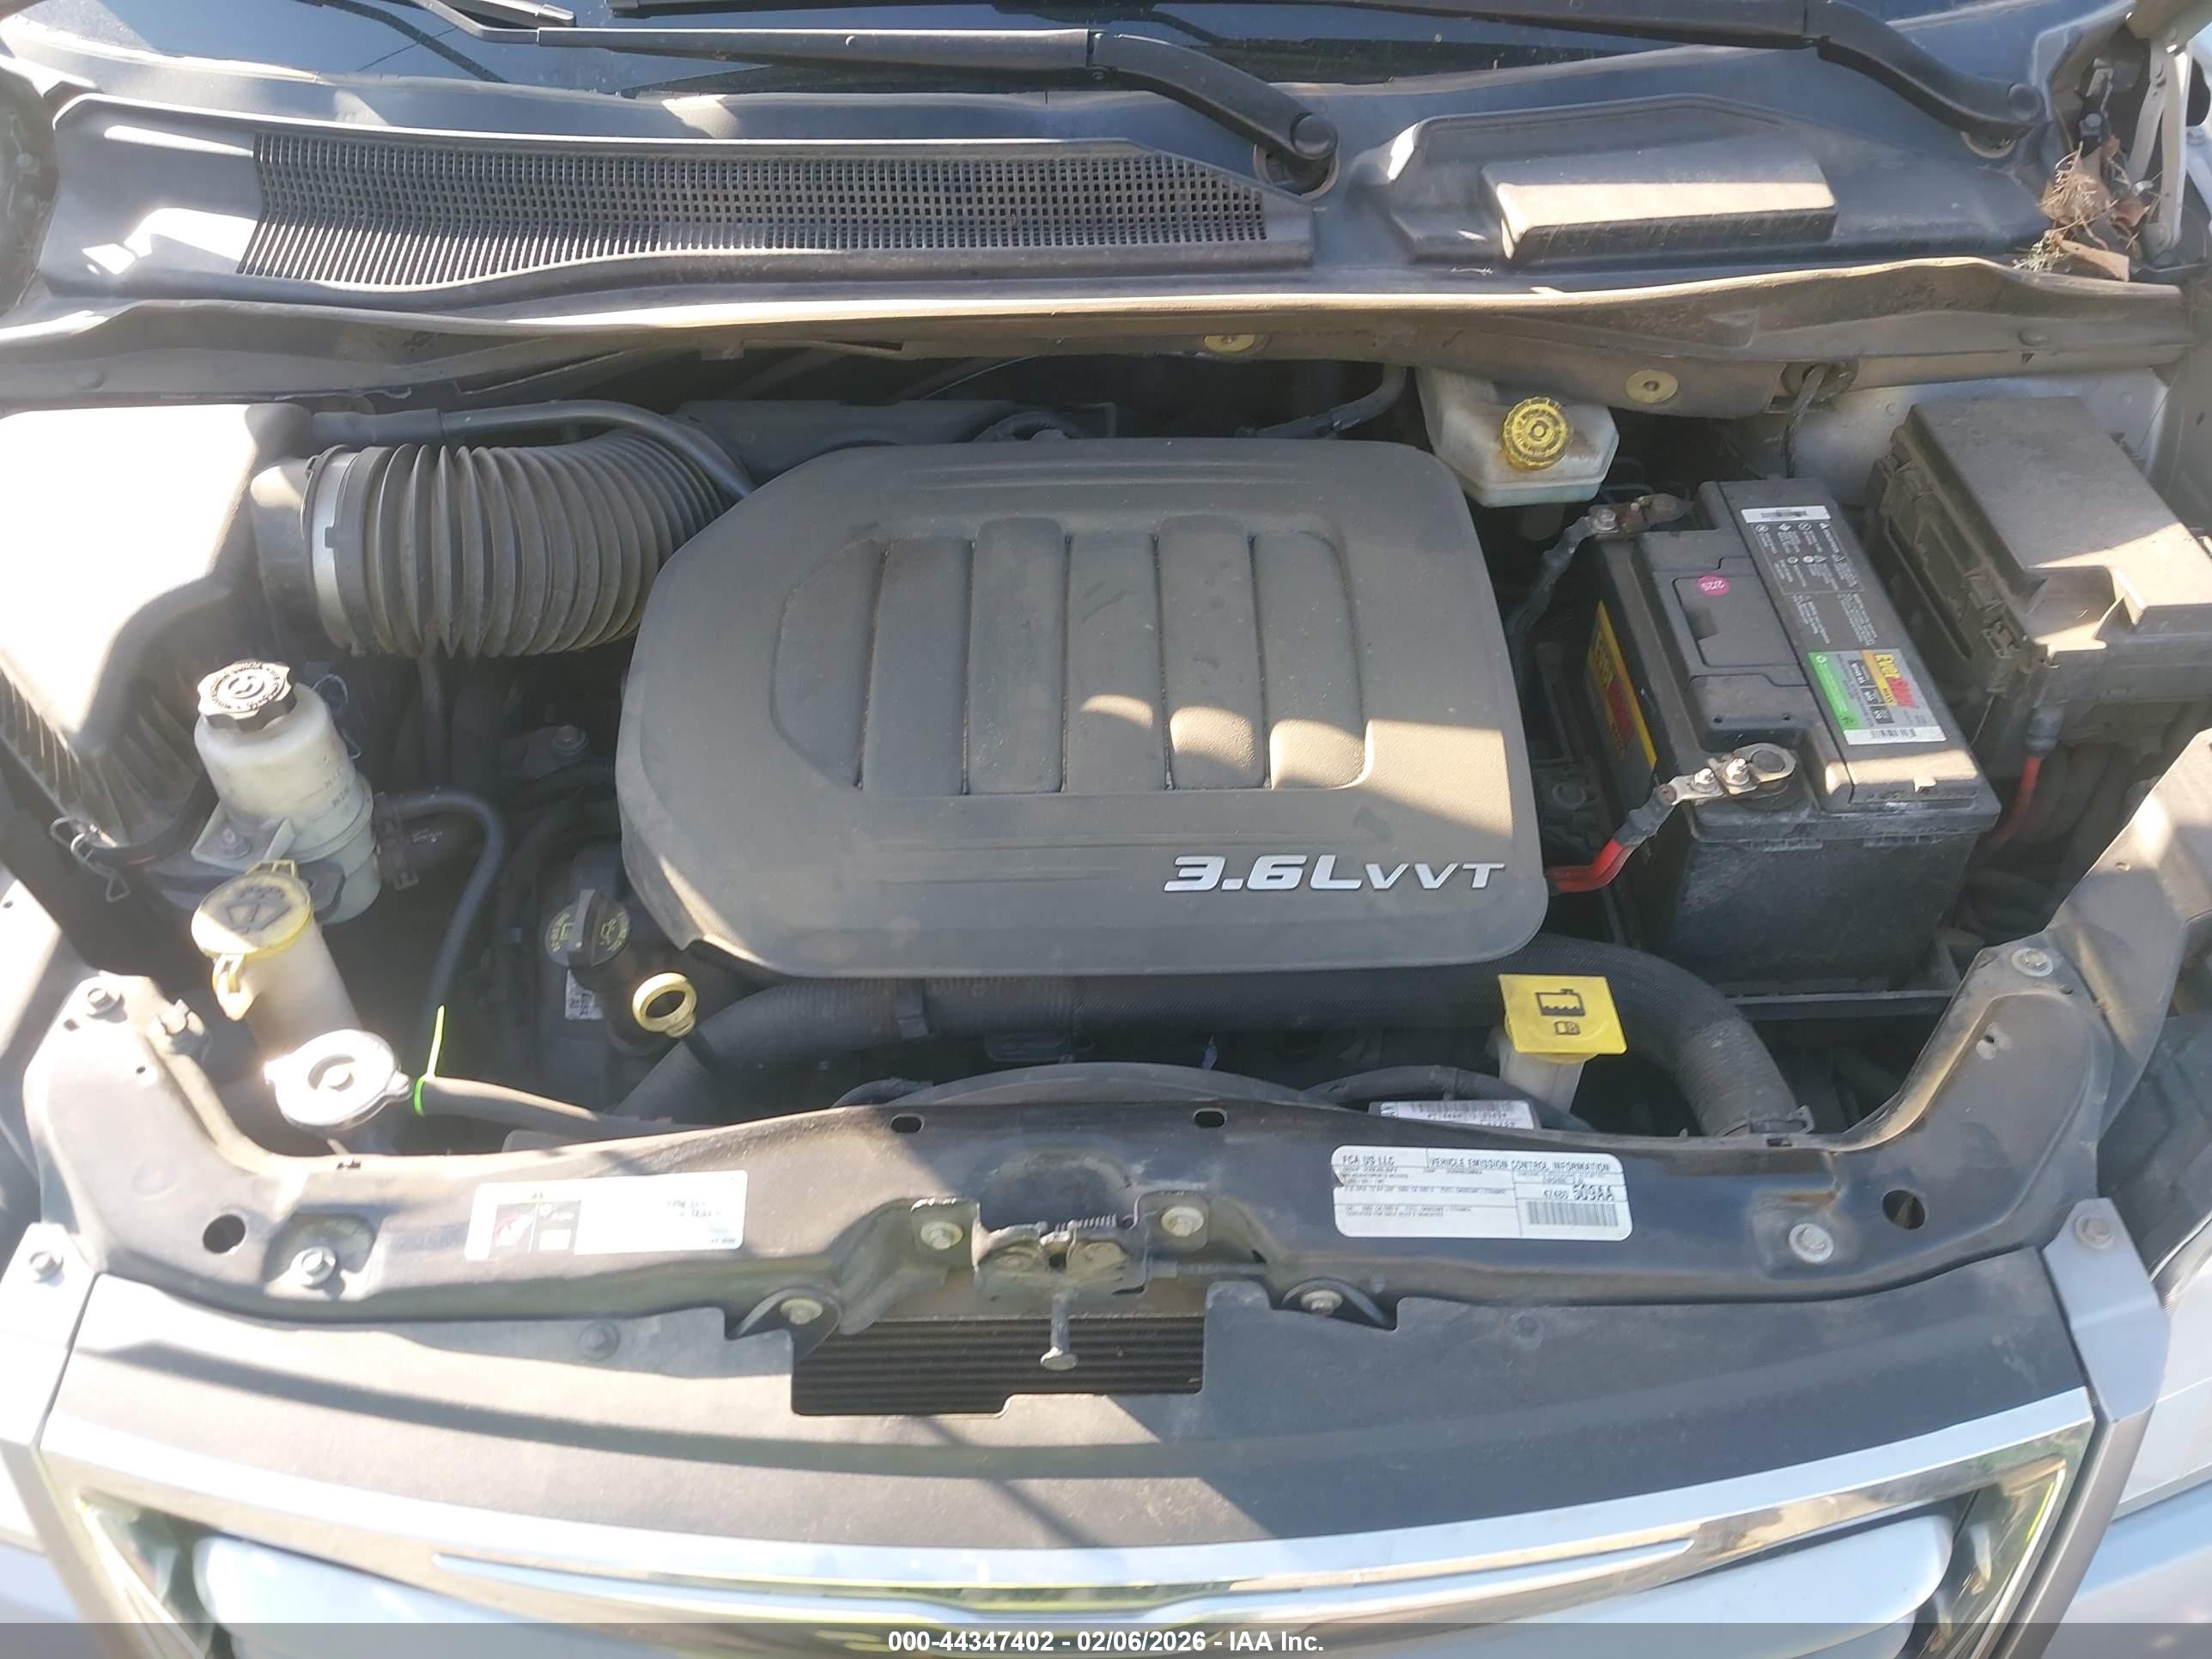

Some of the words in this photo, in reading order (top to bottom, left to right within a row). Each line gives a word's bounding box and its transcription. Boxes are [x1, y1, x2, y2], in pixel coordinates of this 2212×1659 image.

[1342, 1155, 1358, 1166] FCA
[1363, 1155, 1376, 1167] US
[1378, 1156, 1395, 1167] LLC
[1431, 1158, 1465, 1169] VEHICLE
[1468, 1158, 1508, 1170] EMISSION
[1511, 1160, 1550, 1171] CONTROL
[1553, 1161, 1610, 1172] INFORMATION
